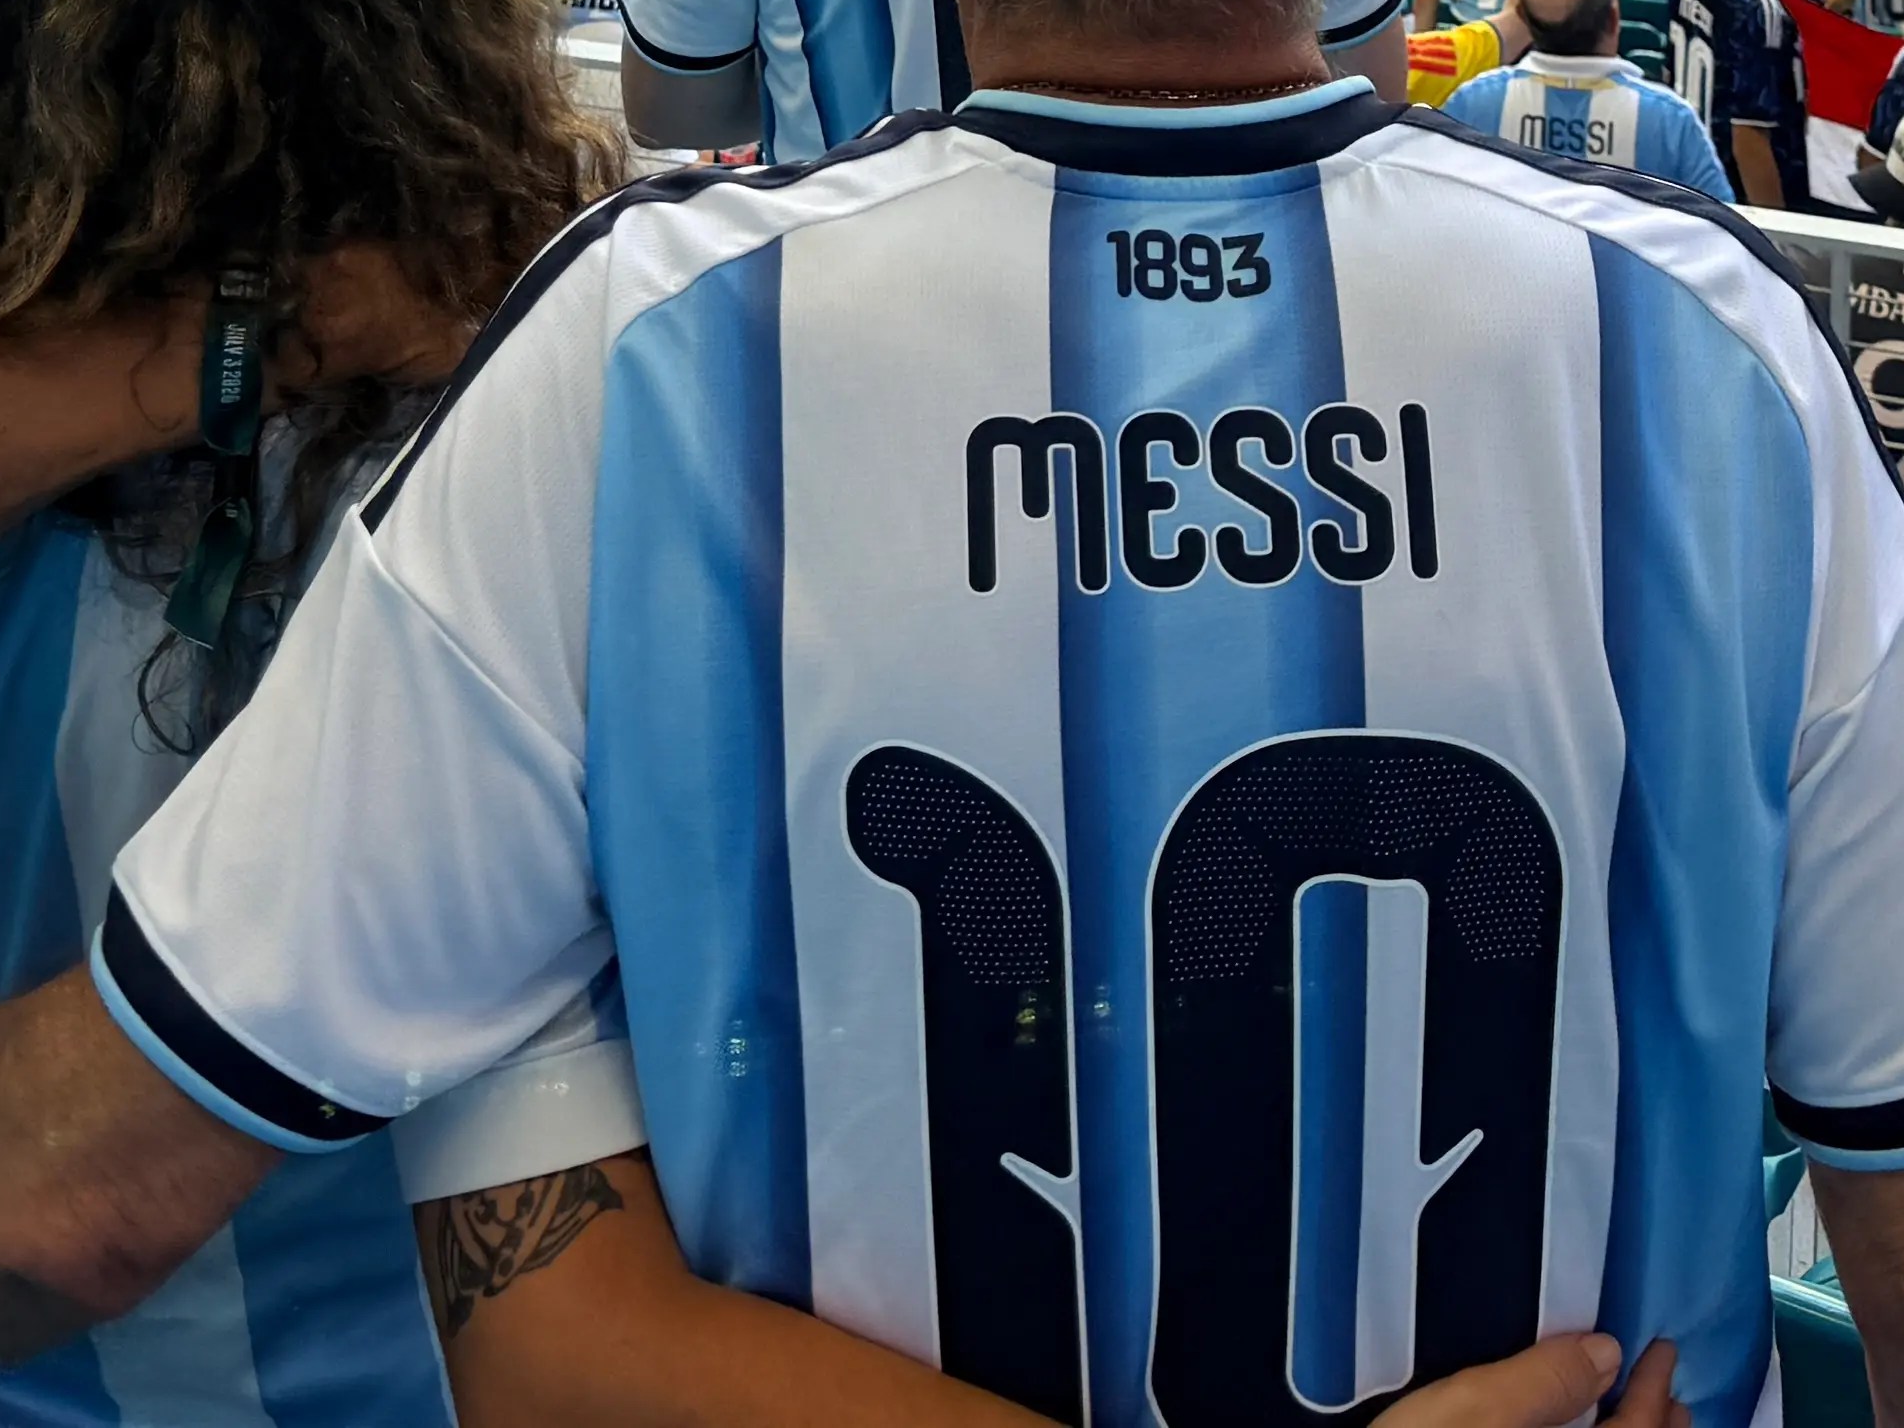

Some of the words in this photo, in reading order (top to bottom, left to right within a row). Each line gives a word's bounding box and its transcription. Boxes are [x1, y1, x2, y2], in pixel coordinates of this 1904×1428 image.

[1521, 113, 1616, 157] MESSI
[1104, 227, 1273, 303] 1893
[963, 400, 1441, 597] MESSI
[841, 726, 1569, 1428] 10
